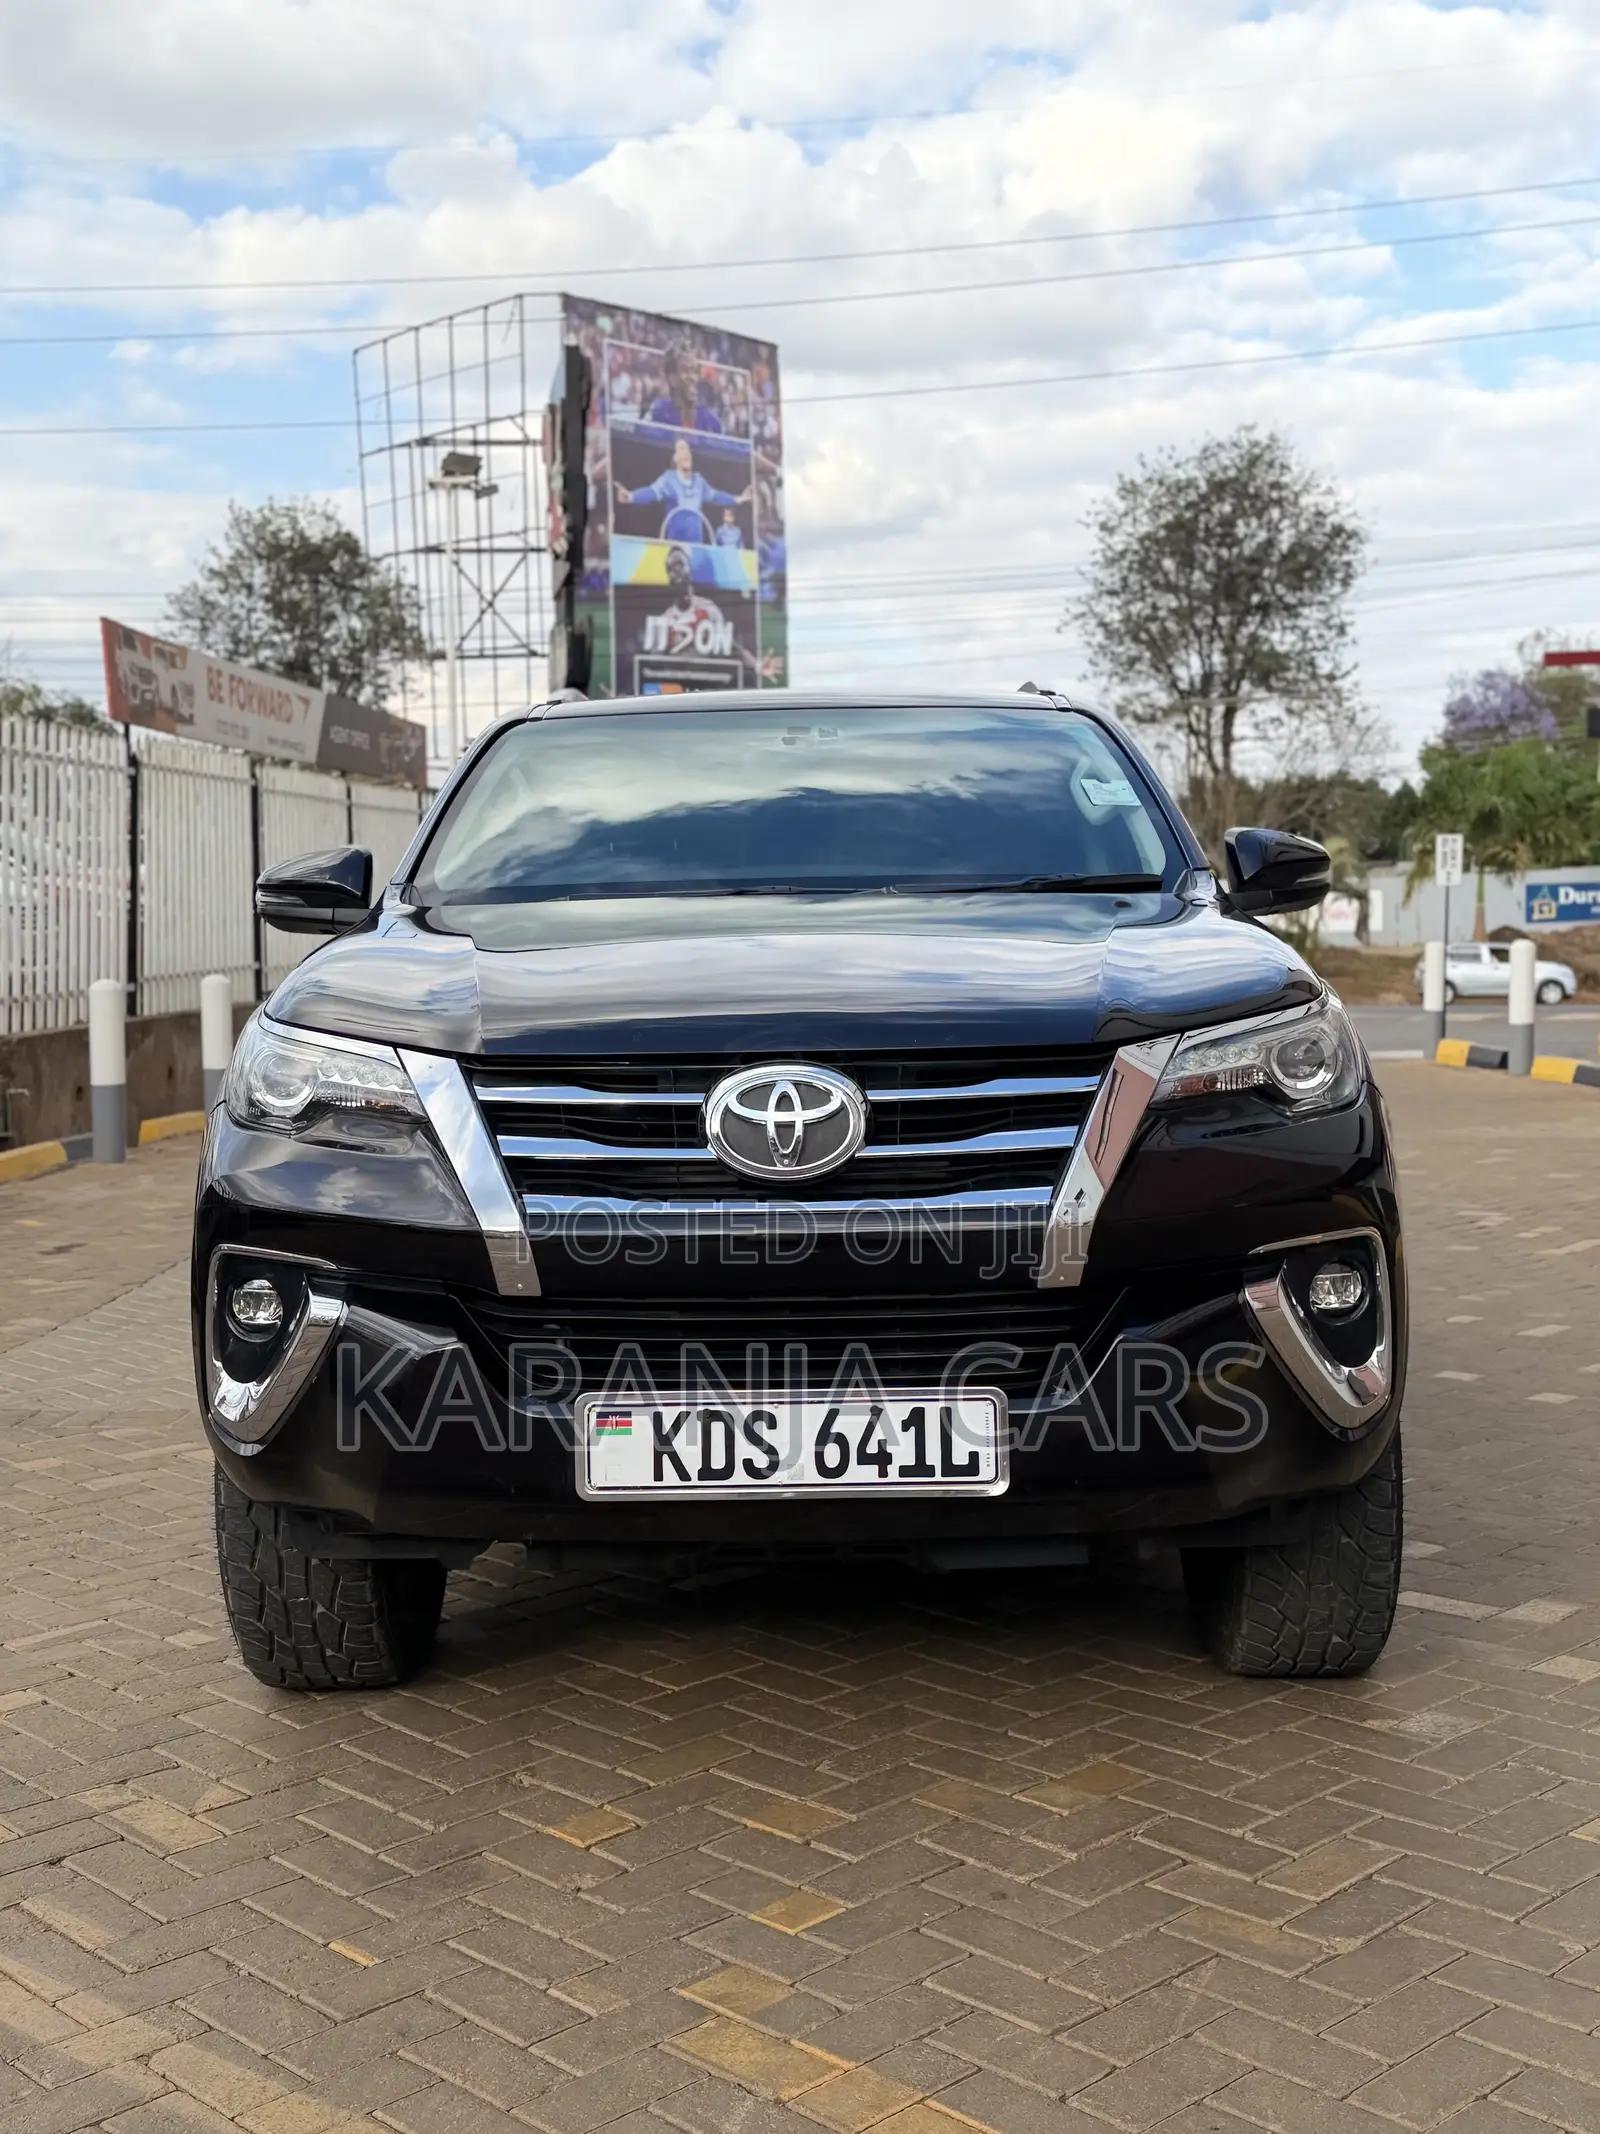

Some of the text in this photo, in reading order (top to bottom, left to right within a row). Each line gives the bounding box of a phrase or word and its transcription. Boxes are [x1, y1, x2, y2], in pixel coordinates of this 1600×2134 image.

[206, 664, 294, 725] BE FORWARD
[653, 1408, 780, 1482] KDS
[814, 1405, 980, 1479] 641L
